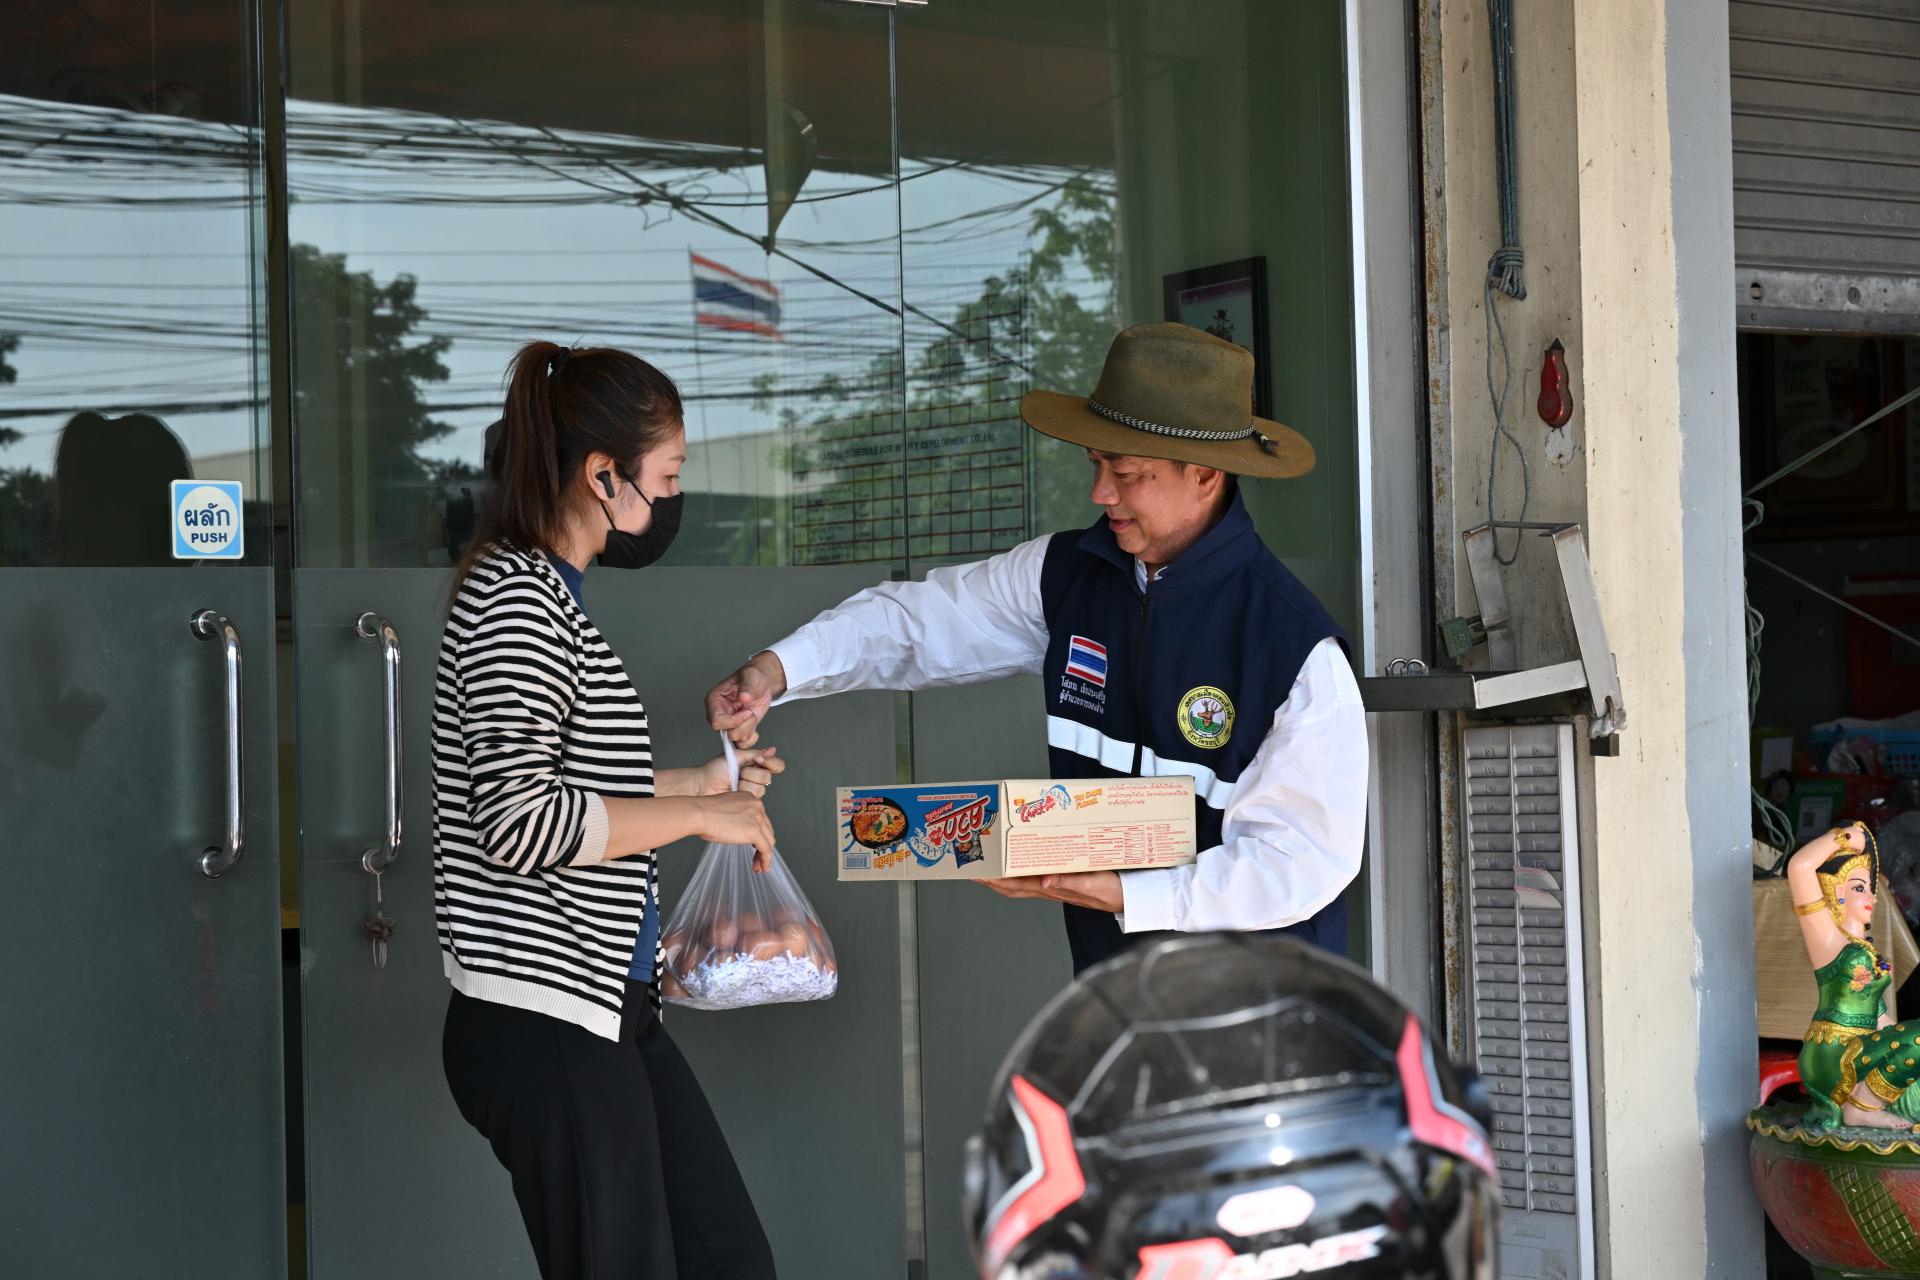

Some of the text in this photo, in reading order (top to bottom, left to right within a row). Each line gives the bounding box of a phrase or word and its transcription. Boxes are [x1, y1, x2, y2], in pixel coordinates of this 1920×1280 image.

[184, 502, 231, 527] ผลัก
[191, 532, 228, 543] PUSH
[943, 805, 983, 842] ควิก
